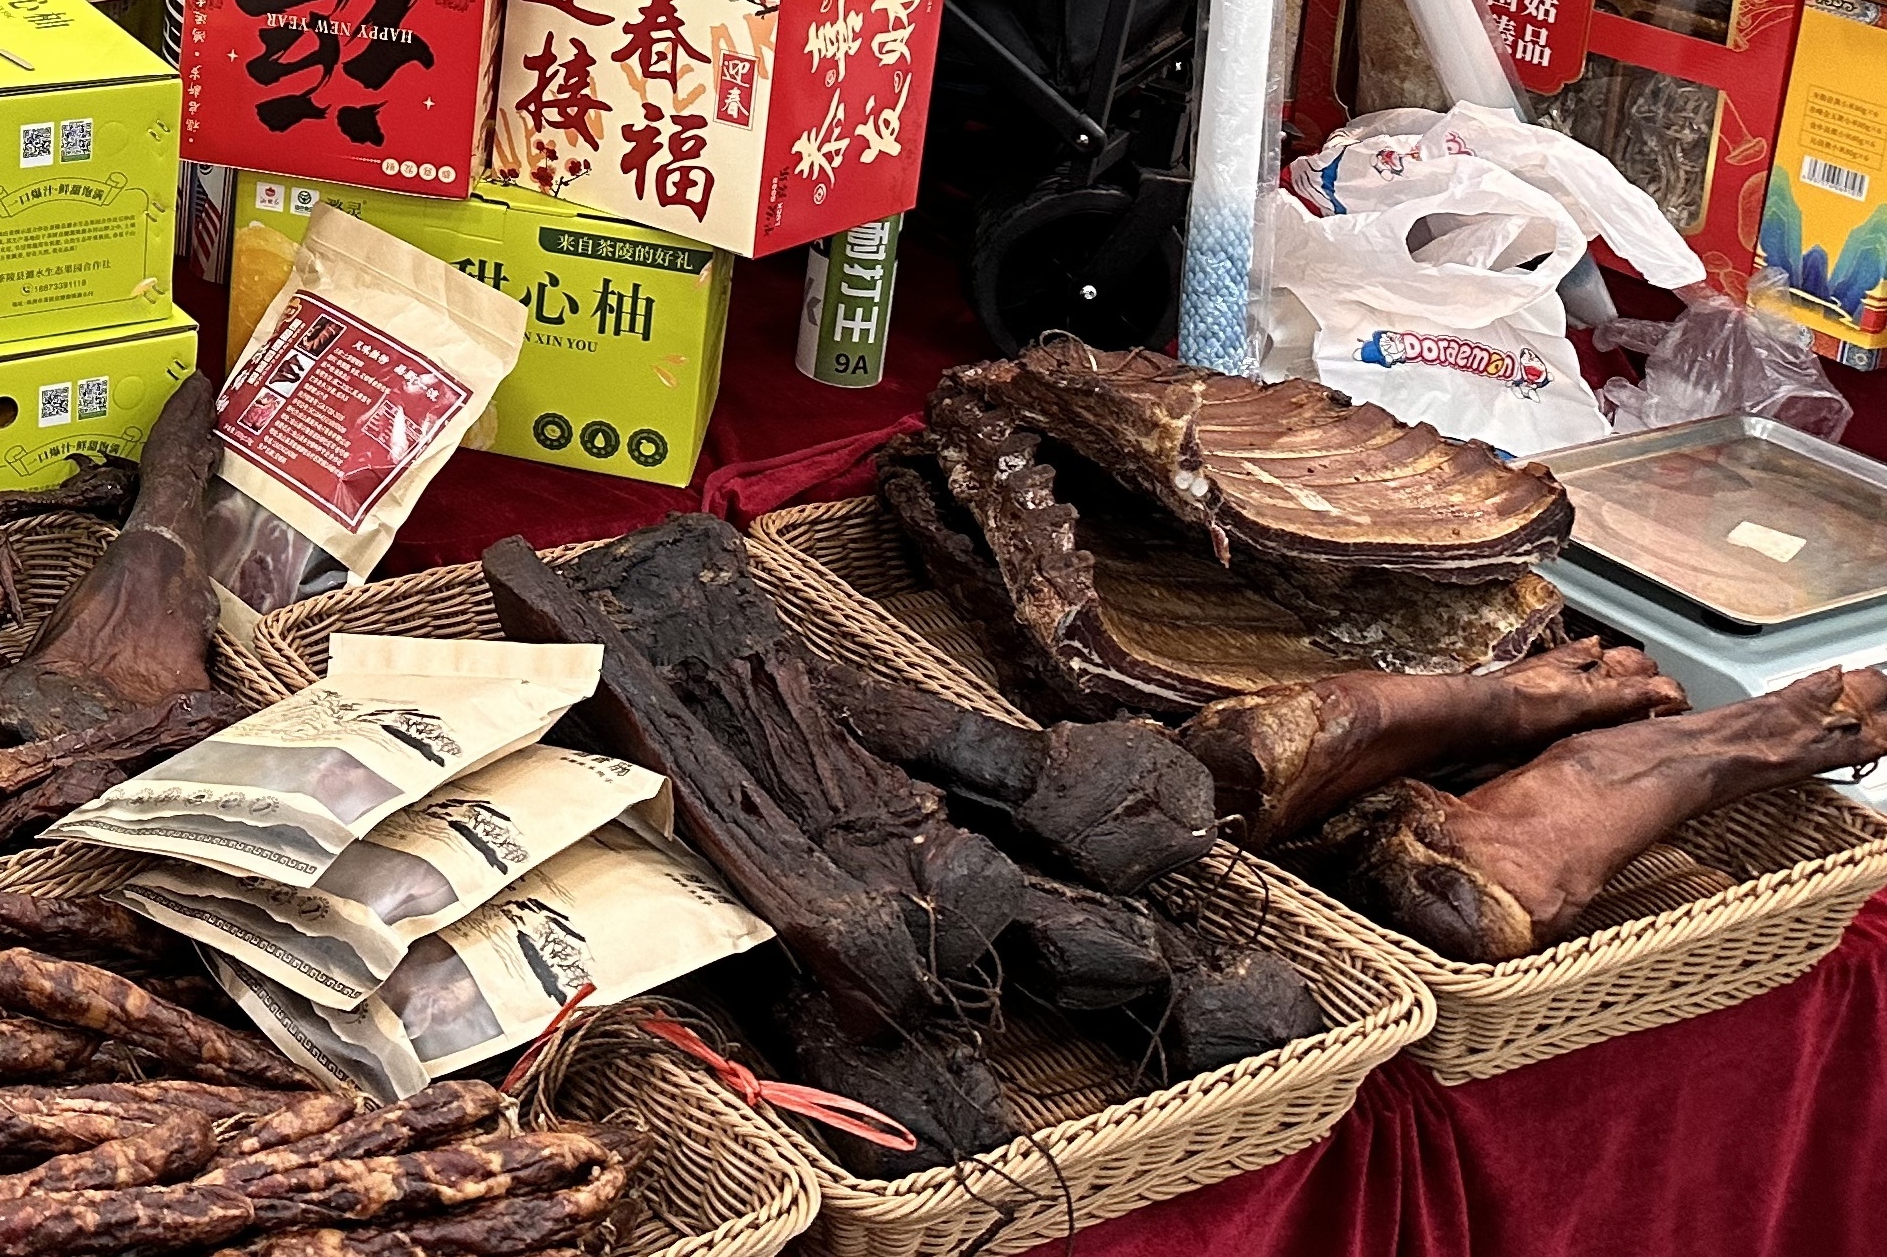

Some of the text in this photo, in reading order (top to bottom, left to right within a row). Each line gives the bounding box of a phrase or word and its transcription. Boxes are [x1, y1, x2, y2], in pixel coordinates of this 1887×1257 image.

[266, 12, 413, 44] HAPPY NEW YEAR
[721, 58, 752, 121] 迎春
[556, 233, 695, 271] 来自茶陵的好礼
[534, 332, 599, 354] XIN YOU
[1401, 331, 1515, 380] Doraemon
[834, 352, 870, 376] 9A
